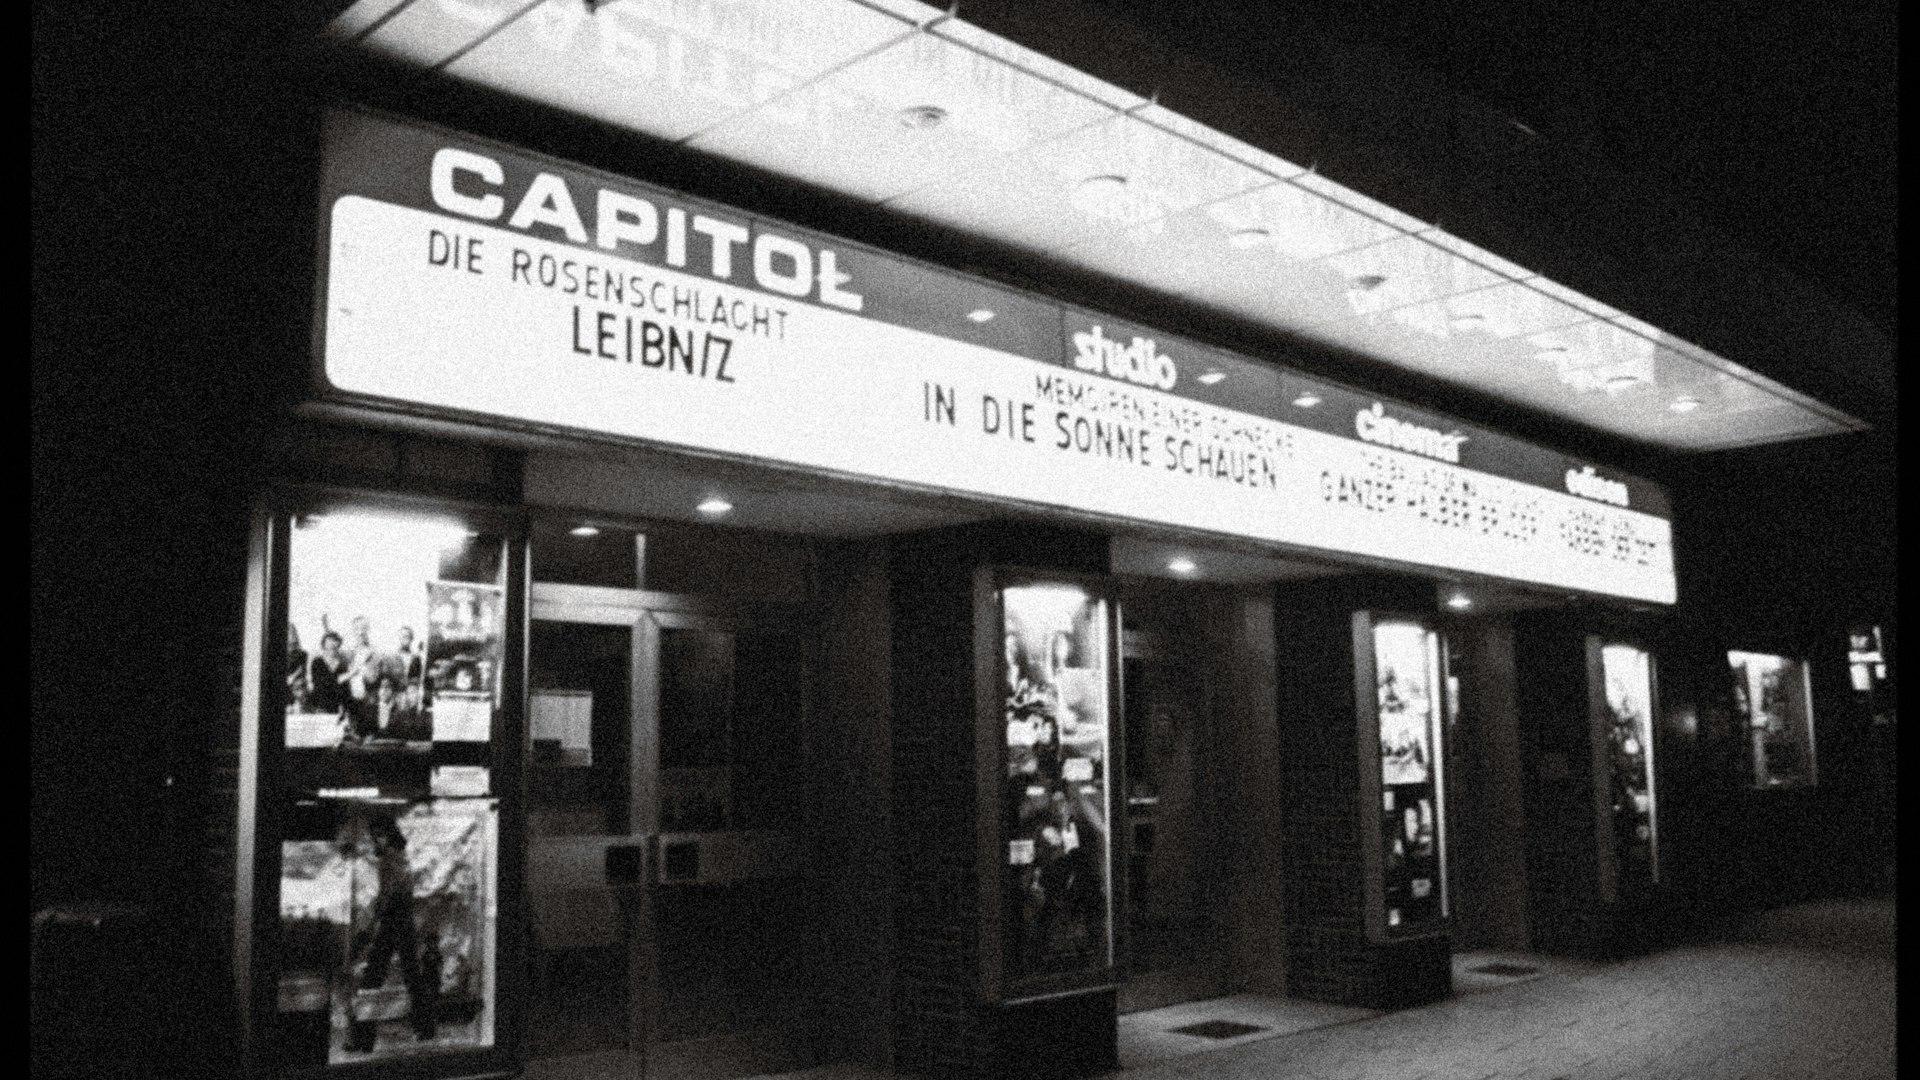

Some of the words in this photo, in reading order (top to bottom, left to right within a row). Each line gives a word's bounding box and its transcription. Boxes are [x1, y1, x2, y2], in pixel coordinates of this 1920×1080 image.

[431, 148, 863, 310] CAPITOL
[428, 229, 484, 274] DIE
[512, 248, 789, 340] ROSENSCHLACHT
[572, 306, 736, 383] LEIBNIZ
[1073, 326, 1176, 389] studio
[924, 382, 955, 426] IN
[982, 395, 1036, 444] DIE
[1056, 410, 1151, 467] SONNE
[1165, 435, 1277, 490] SCHAUEN
[1036, 374, 1145, 420] MEMOREN
[1152, 402, 1202, 433] ENER
